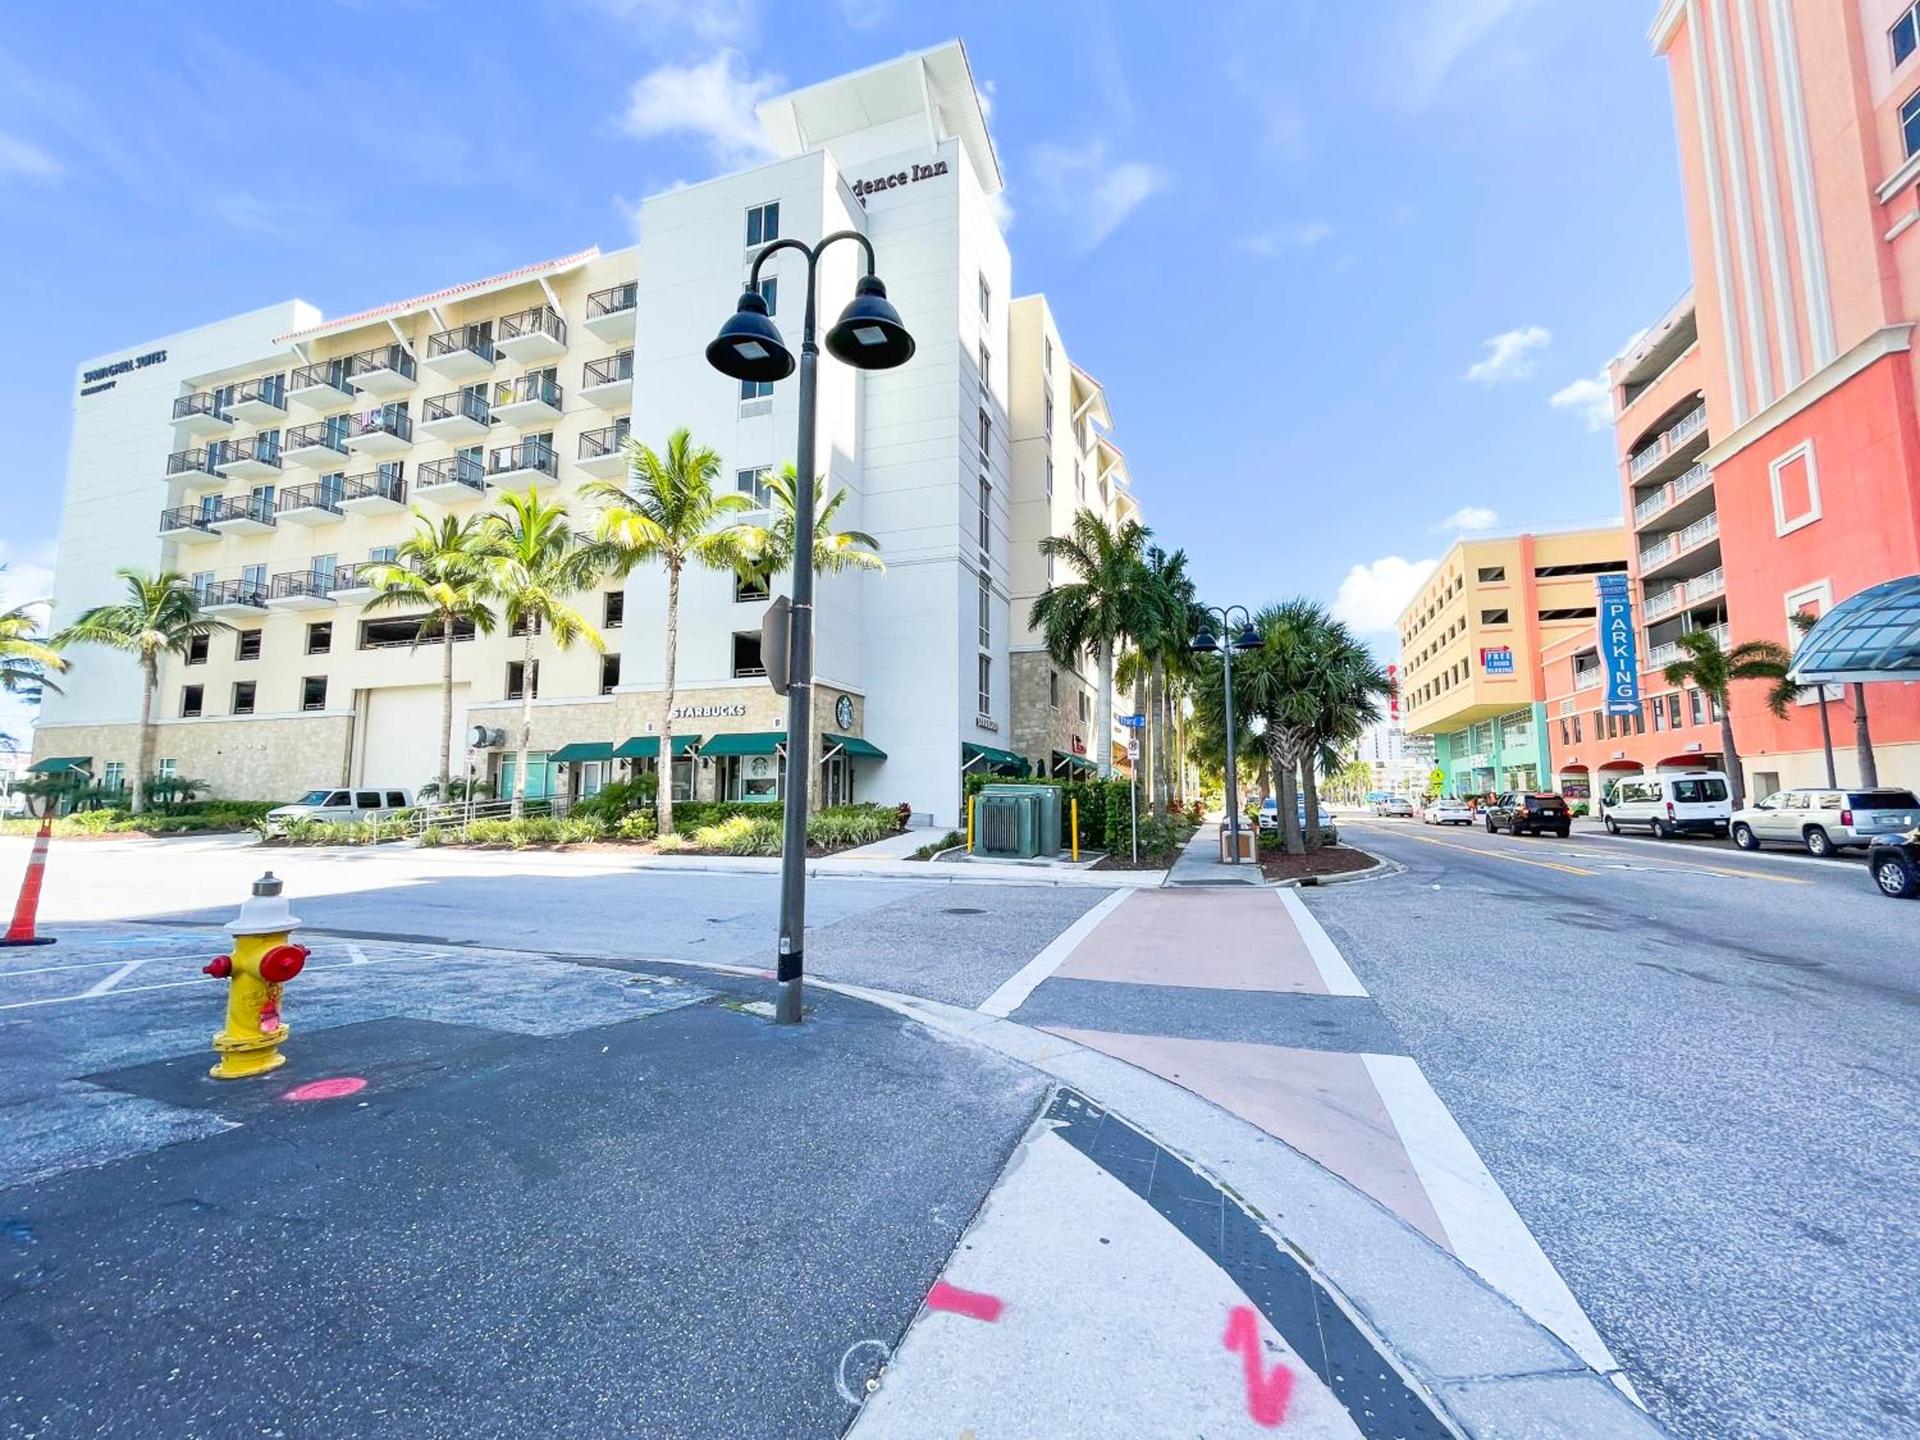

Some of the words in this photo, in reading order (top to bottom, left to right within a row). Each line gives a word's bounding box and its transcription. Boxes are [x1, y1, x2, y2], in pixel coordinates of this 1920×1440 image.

[911, 160, 948, 182] Inn
[1611, 604, 1633, 697] PARKING
[671, 704, 746, 718] STARBUCKS
